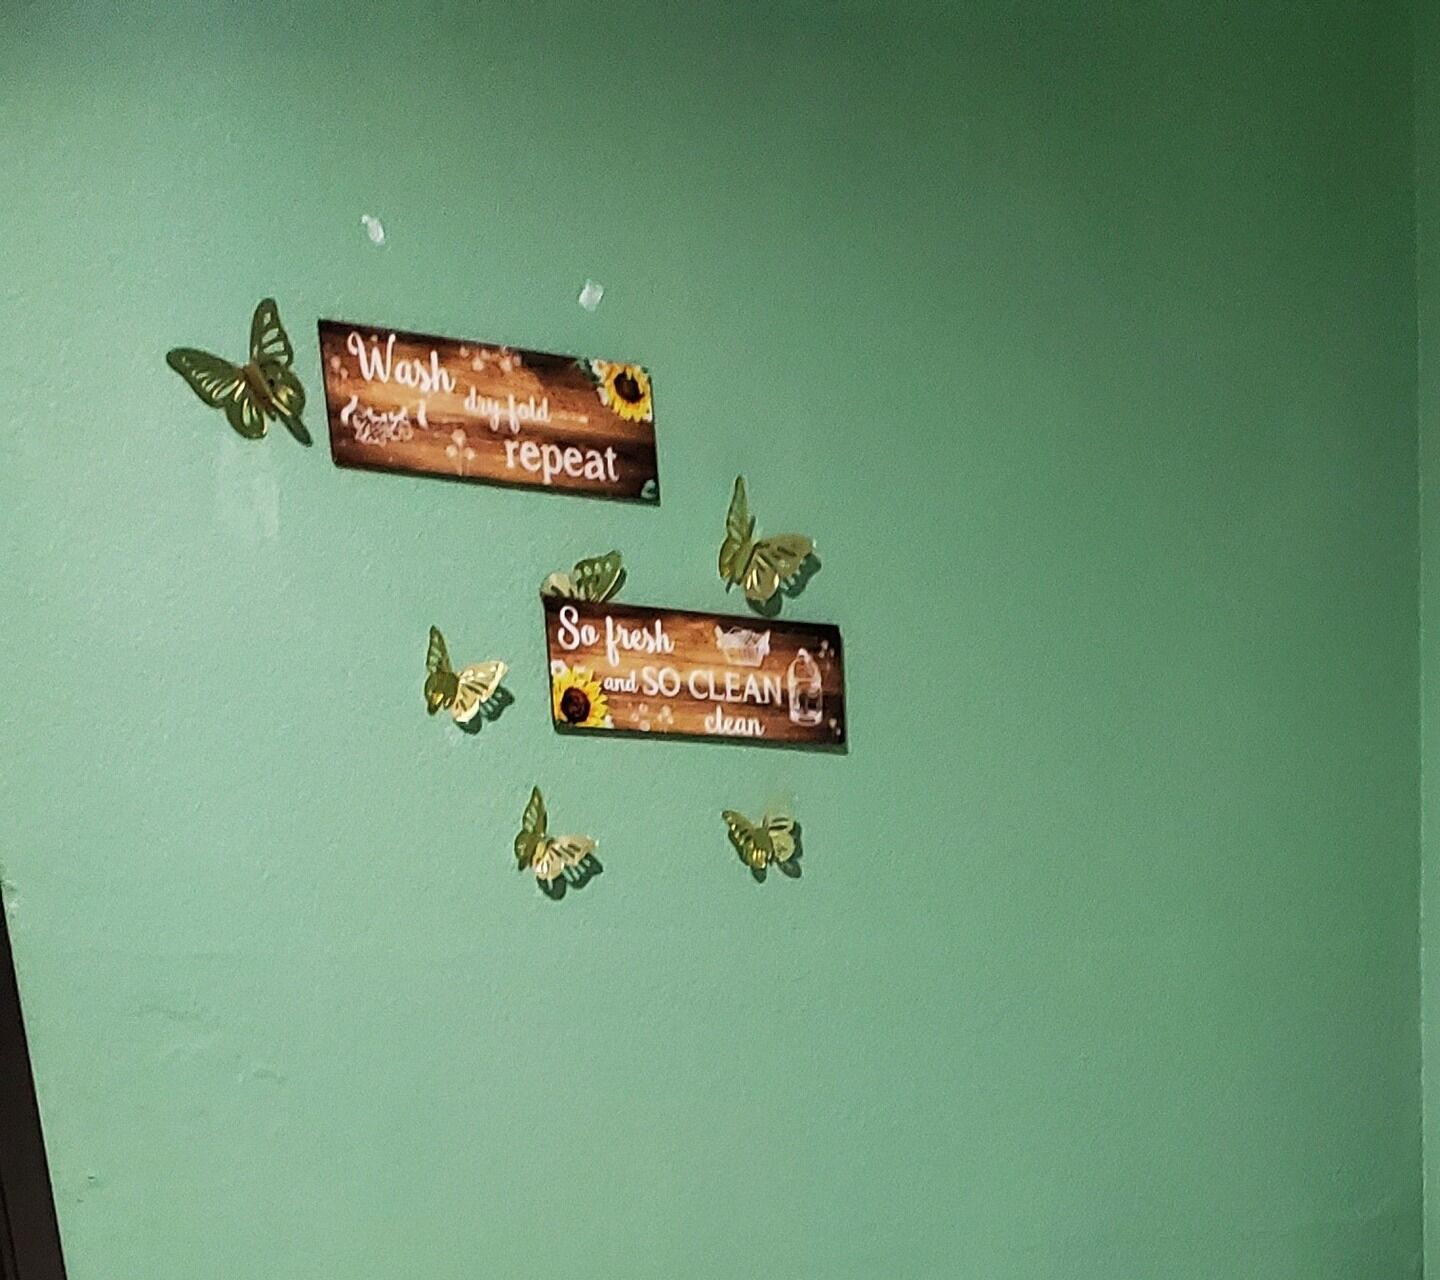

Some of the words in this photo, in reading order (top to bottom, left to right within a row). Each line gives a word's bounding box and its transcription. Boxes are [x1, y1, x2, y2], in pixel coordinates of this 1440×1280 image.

[347, 332, 455, 392] Wash
[464, 385, 500, 432] dry
[500, 393, 550, 434] fold
[504, 439, 619, 484] repeat
[557, 605, 599, 650] So
[605, 616, 675, 667] fresh
[603, 670, 638, 693] and
[640, 665, 681, 698] SO
[687, 668, 783, 705] CLEAN
[704, 706, 765, 737] clean
